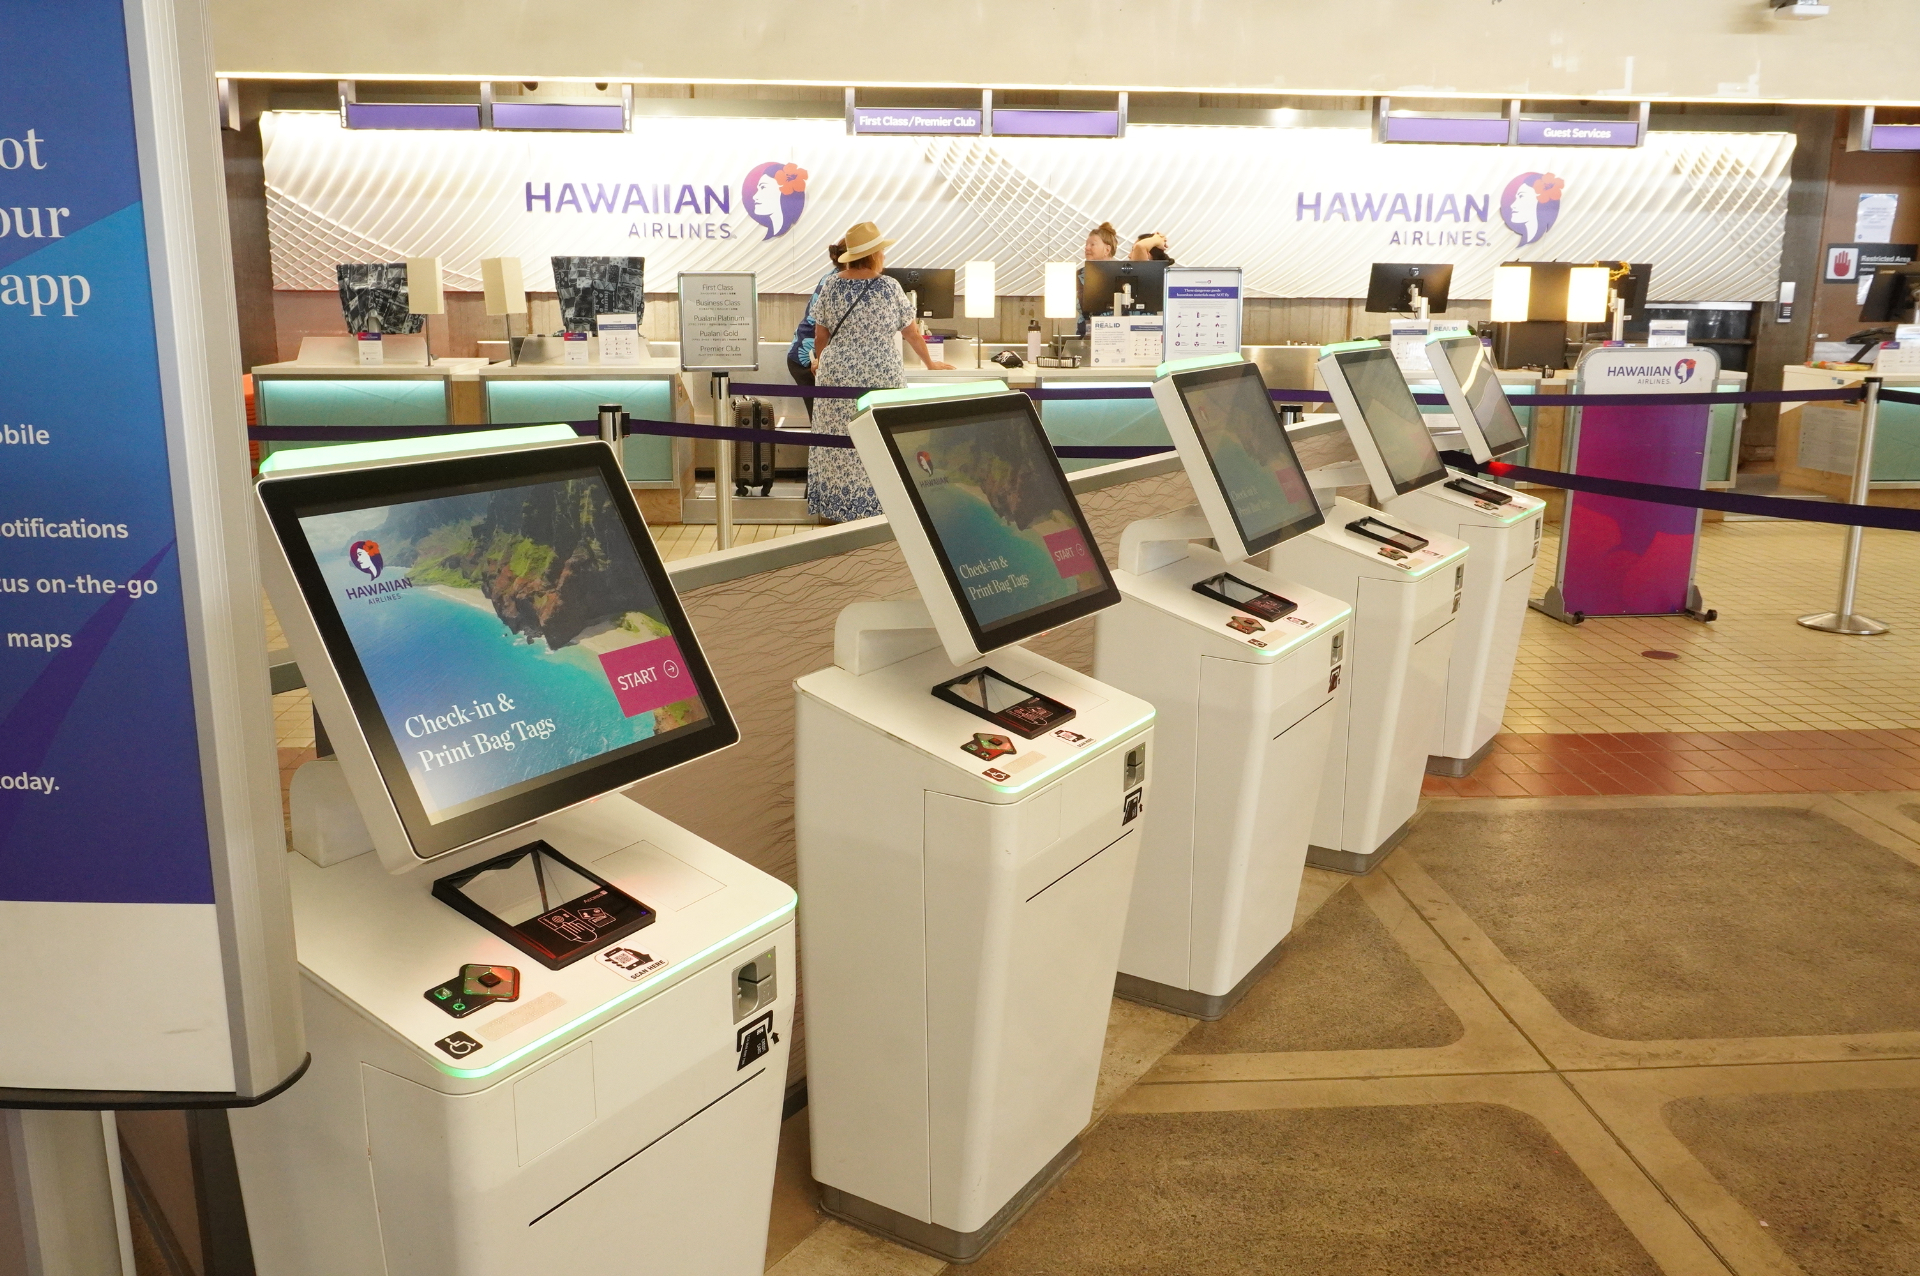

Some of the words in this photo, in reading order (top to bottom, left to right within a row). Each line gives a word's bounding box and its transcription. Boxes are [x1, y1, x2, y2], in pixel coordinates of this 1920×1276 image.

[859, 116, 881, 126] First
[953, 117, 976, 127] Club
[1543, 127, 1571, 138] Guest
[1572, 128, 1611, 139] Services
[525, 181, 730, 214] HAWAIIAN
[1296, 192, 1489, 222] HAWAIIAN
[0, 274, 91, 317] app
[1607, 366, 1671, 377] HAWAIIAN
[0, 424, 50, 445] bile
[0, 517, 129, 539] otifications
[1054, 547, 1074, 561] START
[959, 558, 1000, 579] Check-in
[1000, 555, 1008, 569] &
[36, 574, 158, 599] on-the-go
[345, 578, 413, 600] HAWAIIAN
[968, 583, 994, 600] Print
[991, 579, 1012, 593] Bag
[1008, 574, 1030, 589] Tags
[368, 593, 402, 605] AIRLINES
[7, 632, 73, 652] maps
[617, 666, 658, 691] START
[405, 700, 497, 738] Check-in
[497, 692, 516, 713] &
[417, 740, 475, 773] Print
[472, 730, 515, 752] Bag
[511, 718, 556, 742] Tags
[0, 771, 60, 795] oday.
[630, 967, 648, 980] SCAN
[648, 959, 666, 972] HERE
